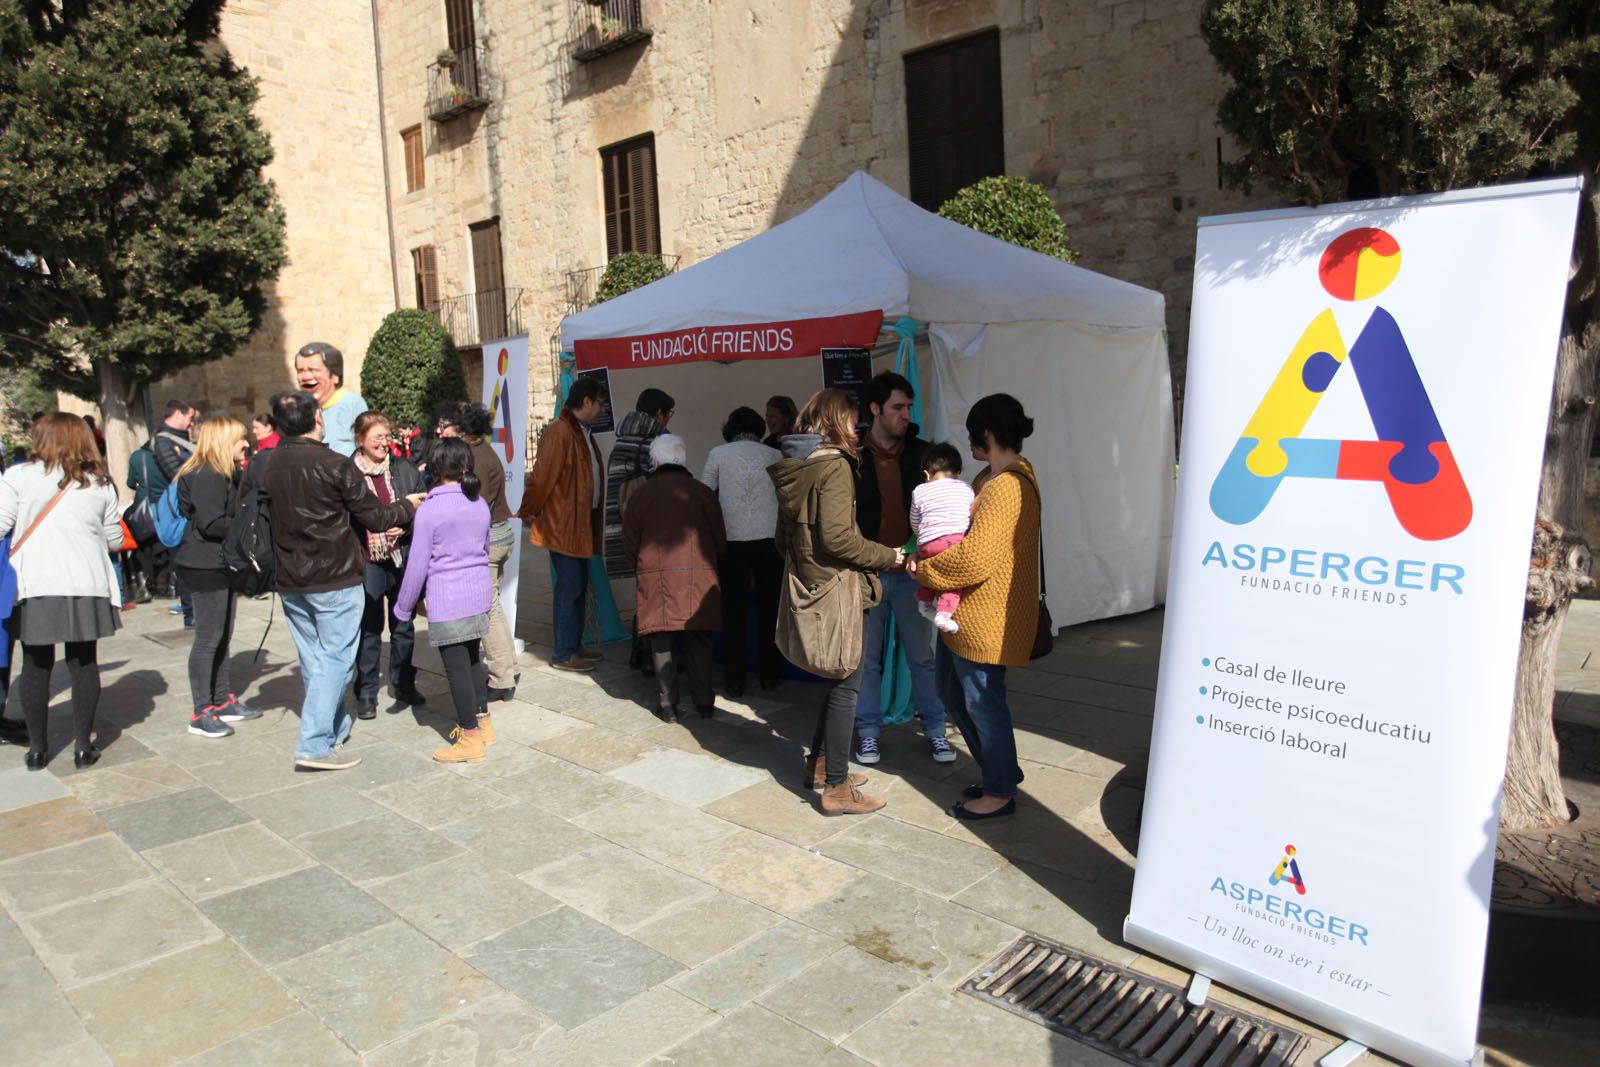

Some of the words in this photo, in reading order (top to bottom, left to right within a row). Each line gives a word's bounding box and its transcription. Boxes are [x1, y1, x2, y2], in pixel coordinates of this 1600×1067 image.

[631, 328, 707, 361] FUNDACIÓ
[711, 328, 793, 353] FRIENDS
[1202, 541, 1465, 595] ASPERGER
[1241, 575, 1322, 596] FUNDACIÓ
[1331, 586, 1408, 606] FRIENDS
[1214, 656, 1258, 678] Casal
[1263, 666, 1286, 684] de
[1292, 669, 1347, 695] lleure
[1209, 714, 1275, 743] Inserció
[1280, 729, 1347, 759] laboral
[1211, 685, 1282, 714] Projecte
[1287, 704, 1431, 744] psicoeducatiu
[1210, 876, 1369, 946] ASPERGER
[1203, 915, 1227, 937] Un
[1232, 926, 1259, 949] lloc
[1263, 943, 1284, 959] on
[1288, 952, 1312, 969] ser
[1317, 960, 1324, 974] i
[1329, 969, 1373, 992] estar
[1290, 923, 1337, 946] FRIENDS
